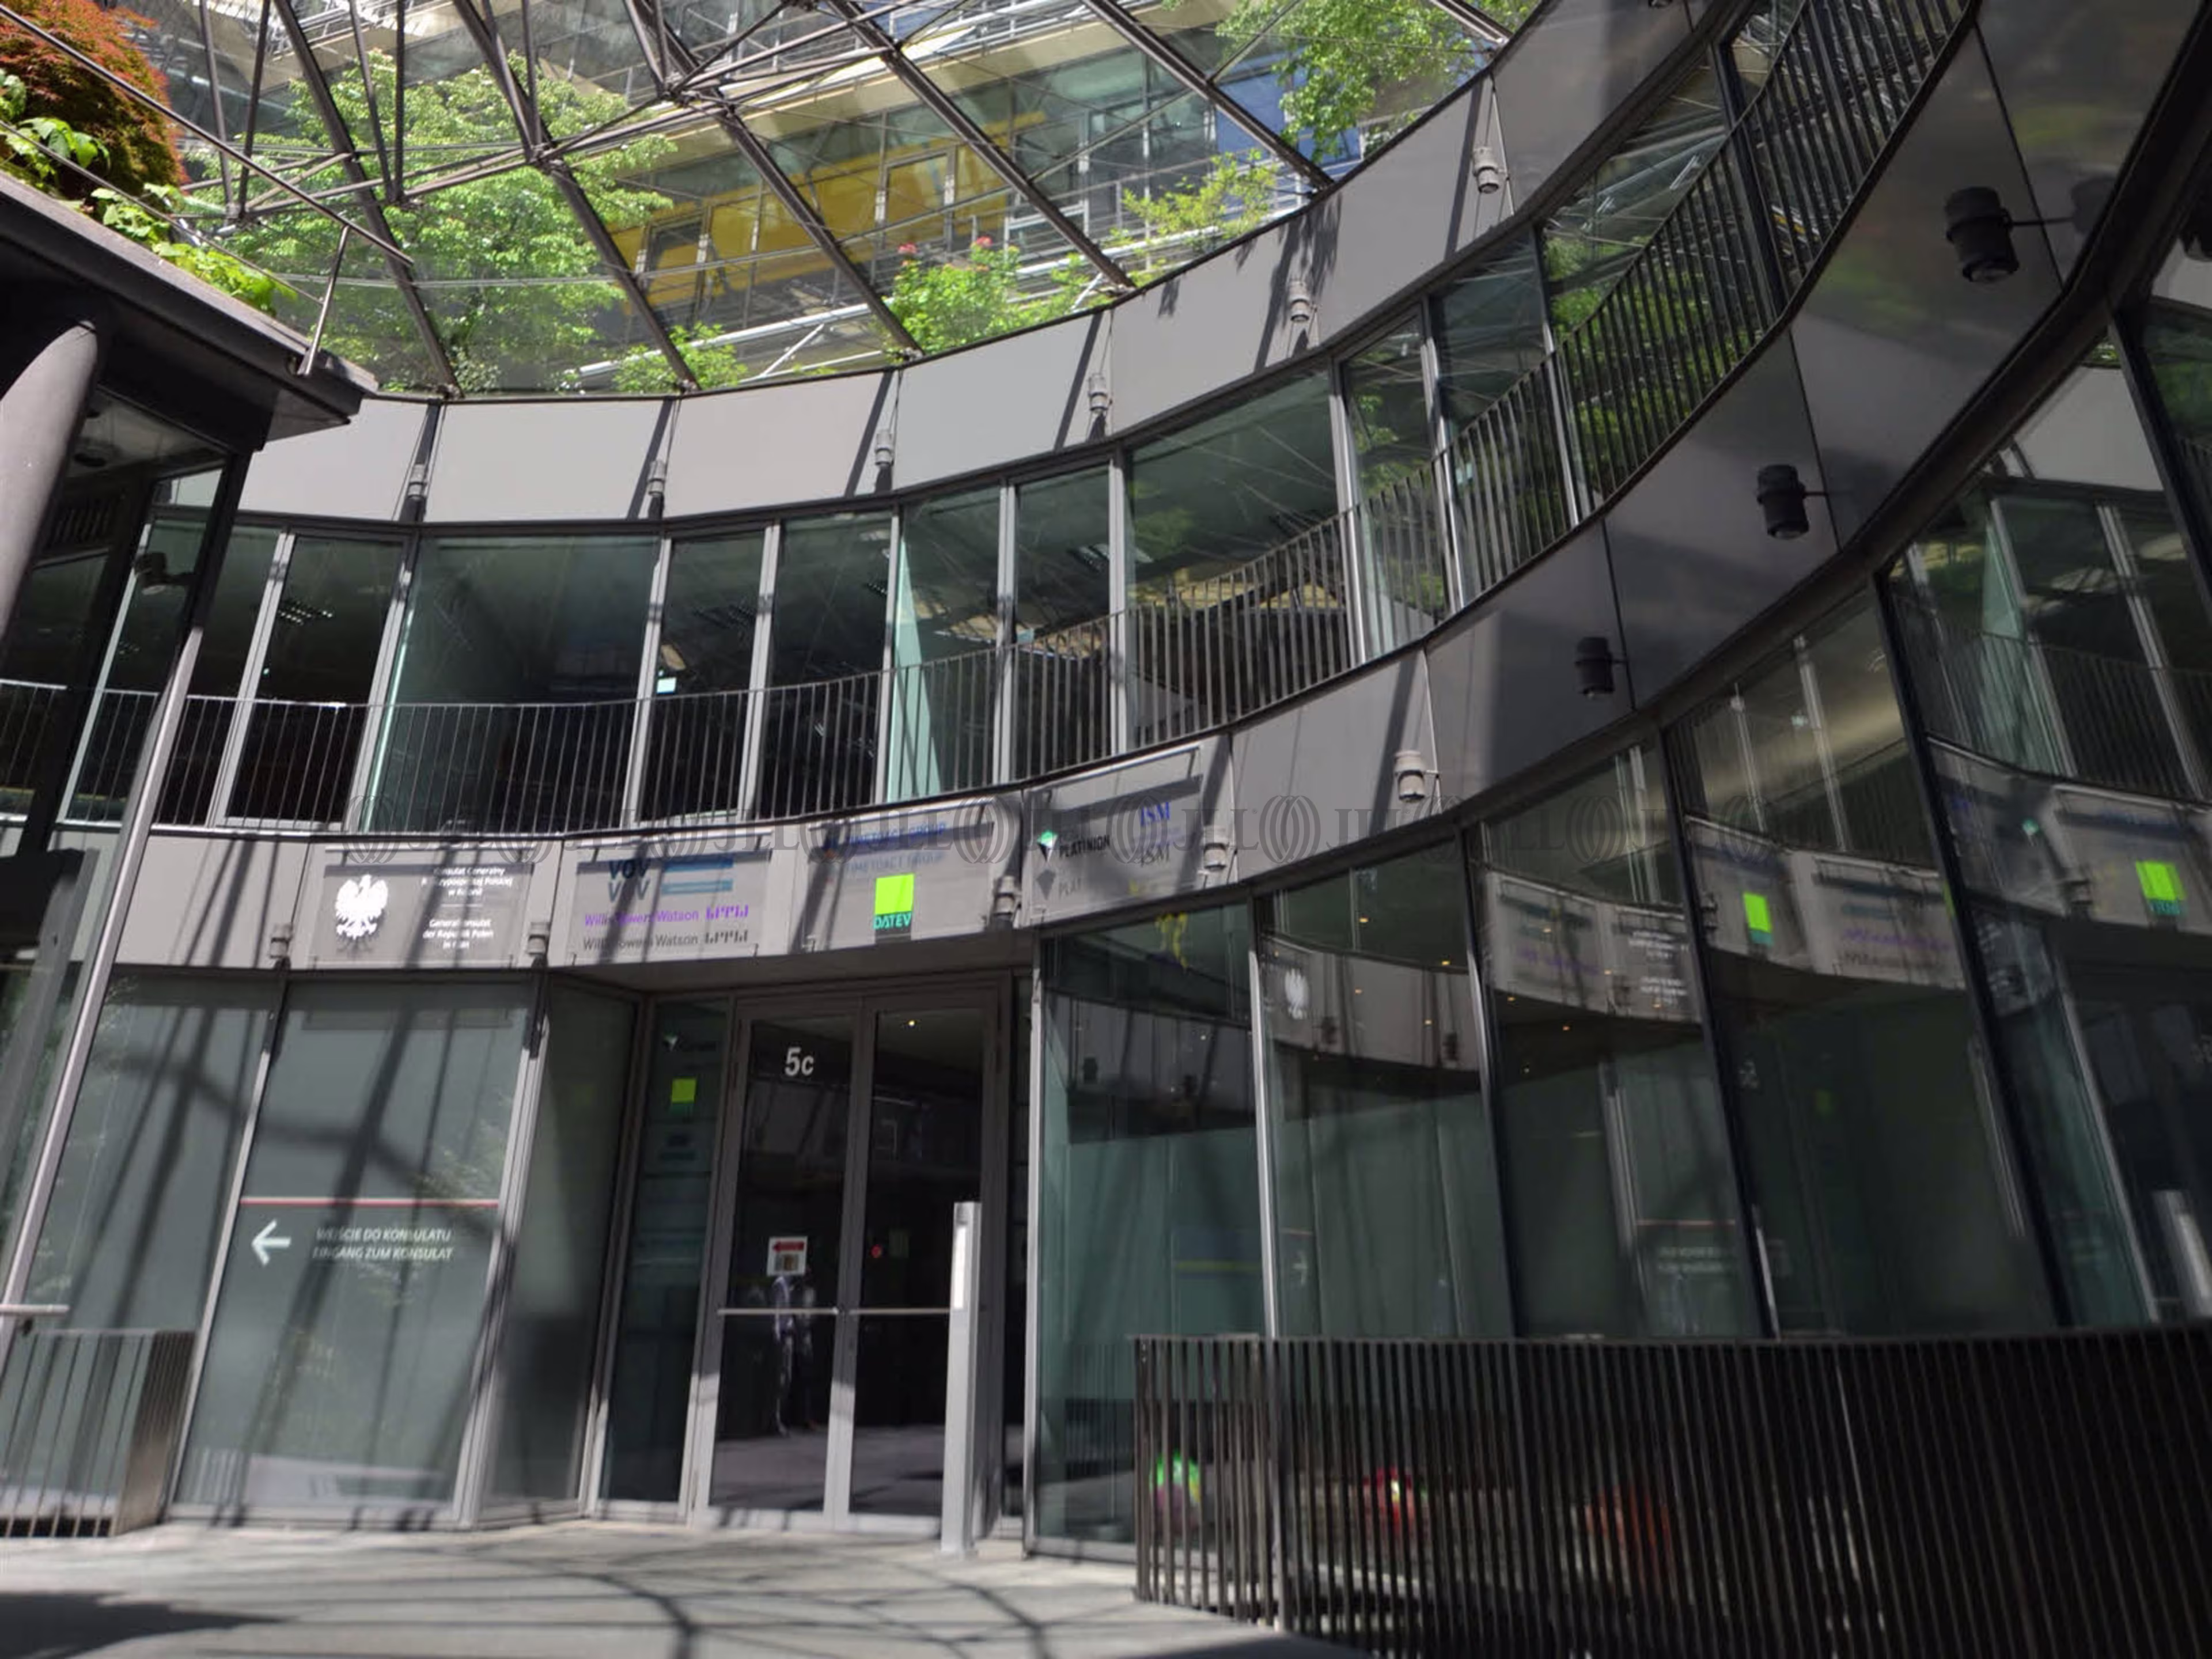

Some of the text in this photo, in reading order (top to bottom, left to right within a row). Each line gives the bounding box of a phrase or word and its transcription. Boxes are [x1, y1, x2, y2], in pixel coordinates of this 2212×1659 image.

[657, 909, 699, 922] Watson
[873, 912, 911, 930] DATEV
[784, 1046, 814, 1076] 5c
[363, 1228, 381, 1241] DO
